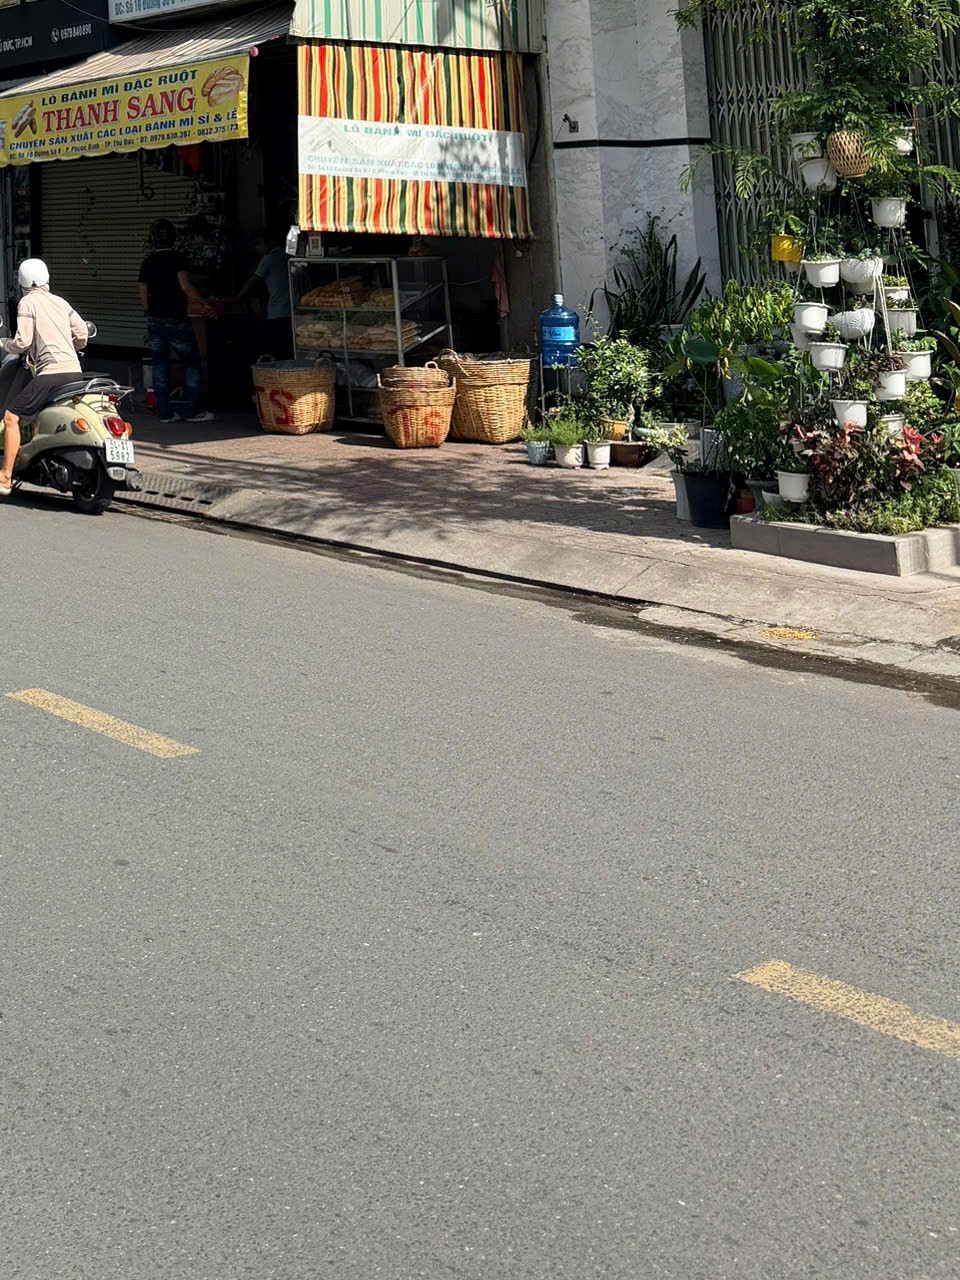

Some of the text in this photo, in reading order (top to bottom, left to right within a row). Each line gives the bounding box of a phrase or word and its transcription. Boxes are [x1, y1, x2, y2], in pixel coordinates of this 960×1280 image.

[61, 87, 97, 104] BÁNH
[158, 70, 199, 88] RUỘT
[43, 86, 196, 133] THANH SANG
[9, 136, 46, 151] CHUYÊN
[213, 113, 223, 123] &
